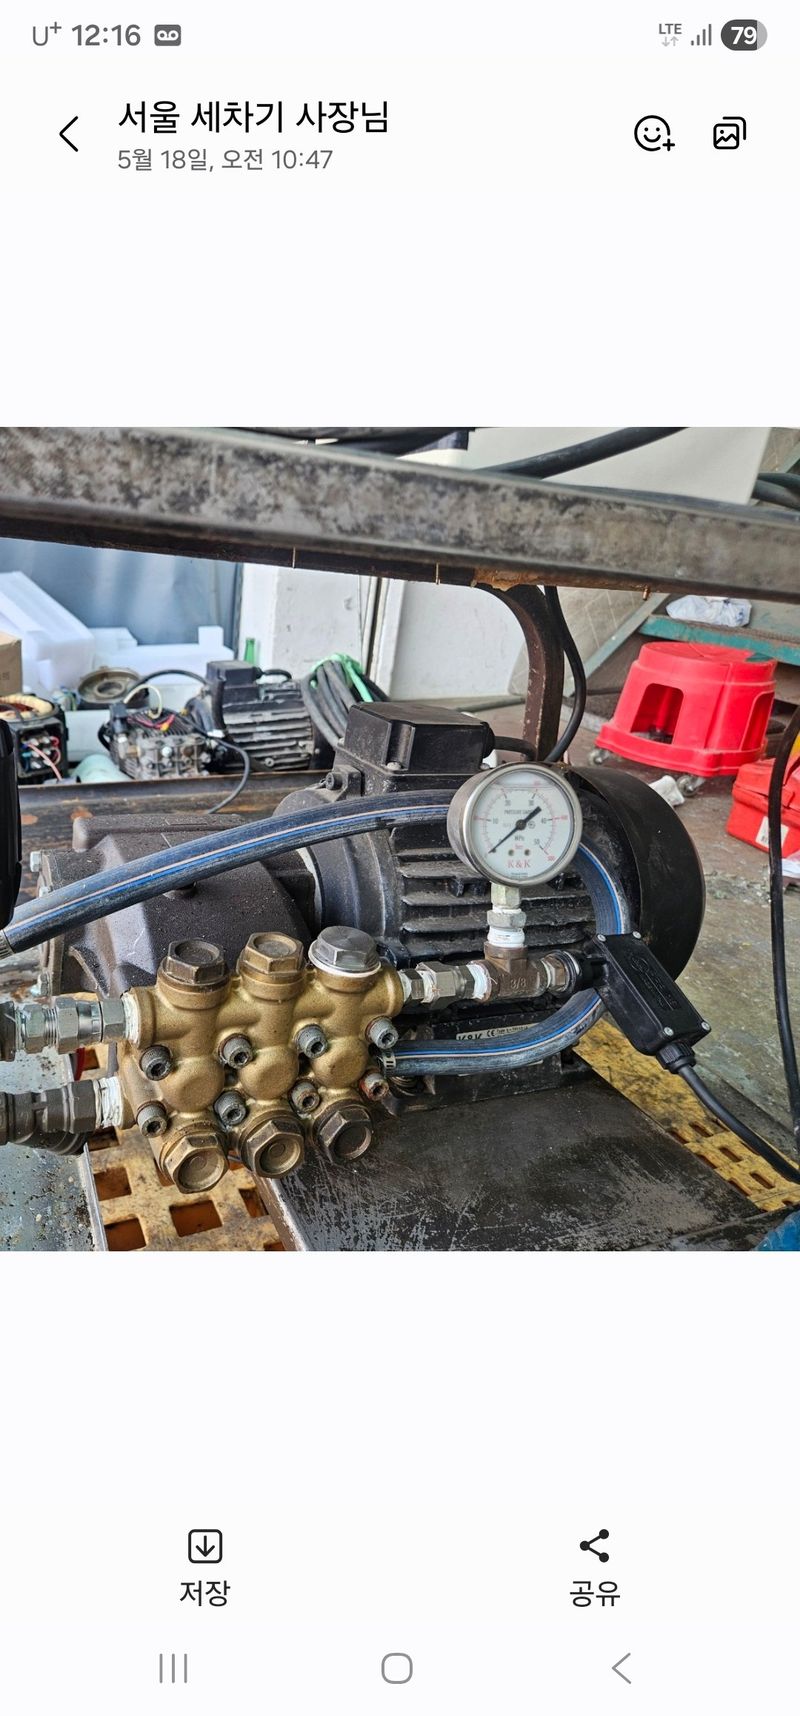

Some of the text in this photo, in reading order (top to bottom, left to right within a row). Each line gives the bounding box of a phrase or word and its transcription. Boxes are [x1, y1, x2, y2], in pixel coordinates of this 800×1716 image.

[71, 23, 141, 47] 12:16
[658, 23, 682, 35] LTE
[730, 25, 757, 46] 79
[118, 100, 388, 134] 서울 세차기 사장님
[117, 148, 334, 173] 5월 18일, 오전 10:47
[509, 977, 527, 989] 3/8
[179, 1579, 231, 1608] 저장
[569, 1580, 621, 1608] 공유
